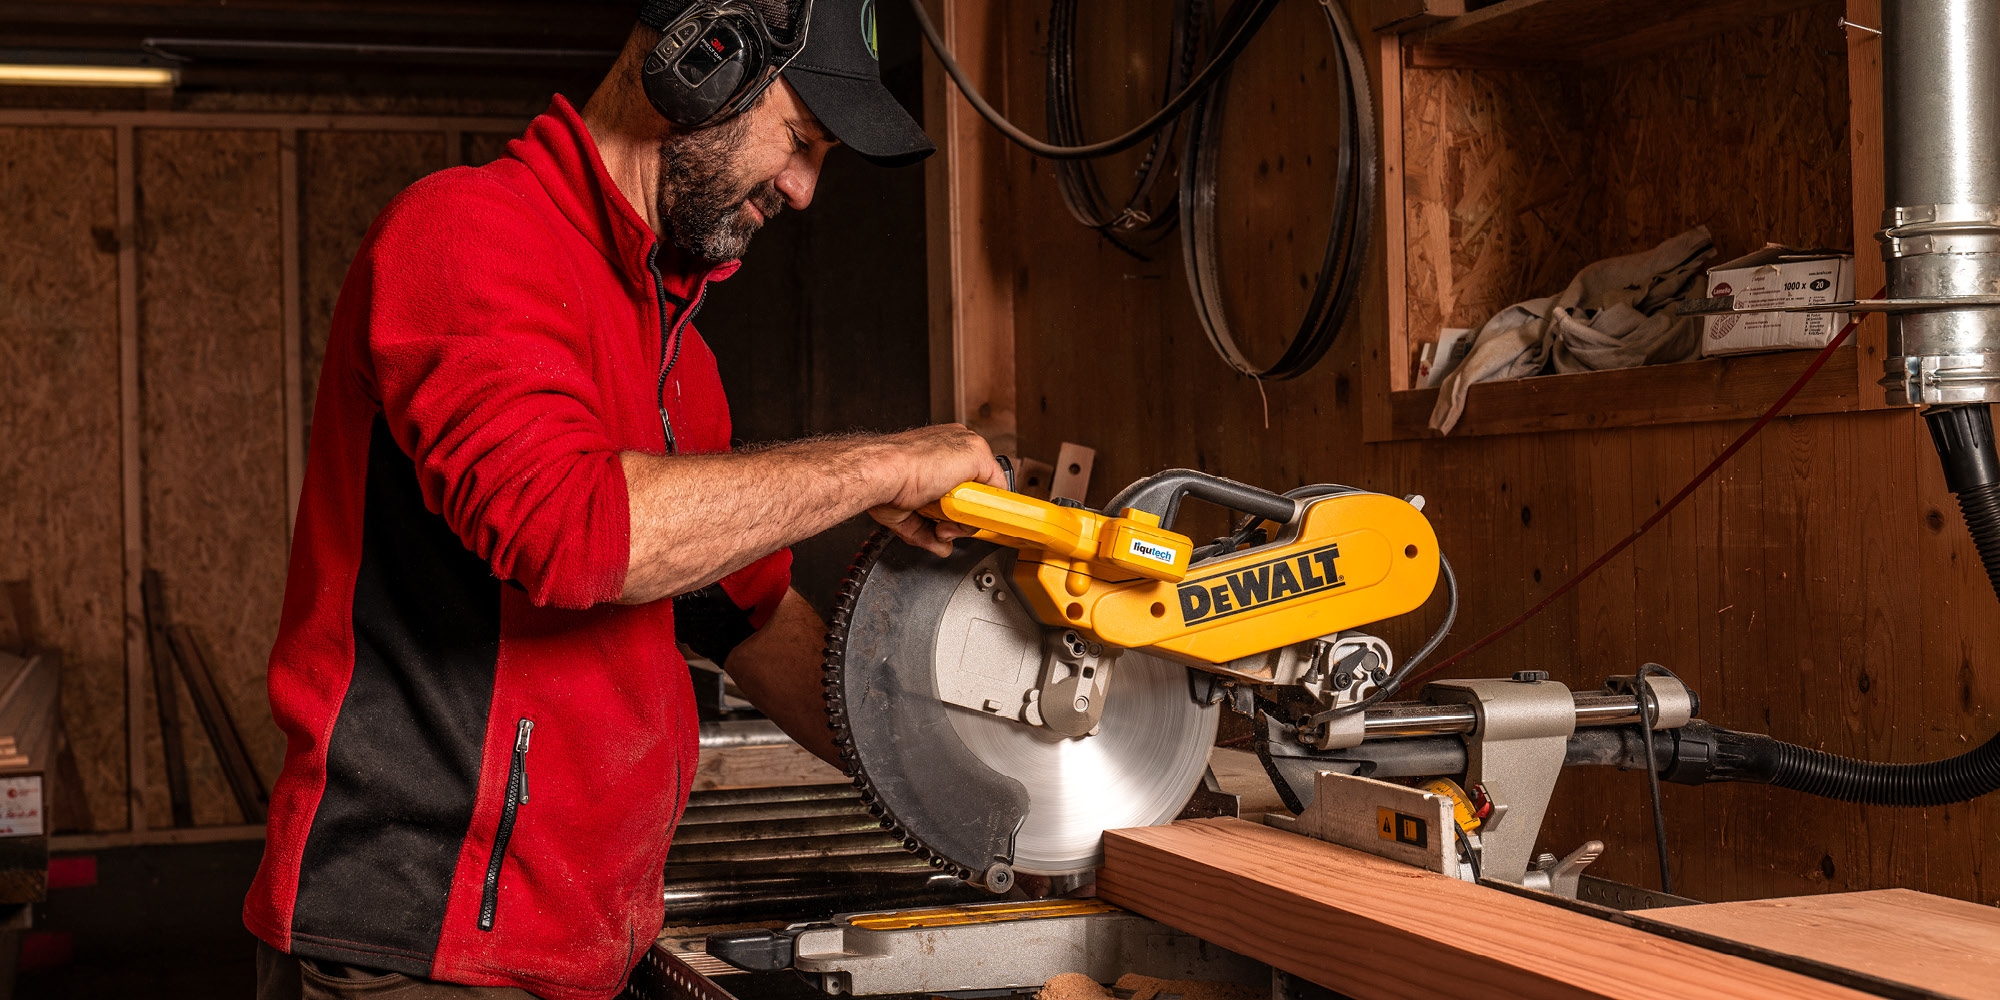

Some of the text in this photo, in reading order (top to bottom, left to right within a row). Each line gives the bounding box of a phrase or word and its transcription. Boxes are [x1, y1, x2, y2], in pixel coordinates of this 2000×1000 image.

[711, 38, 725, 52] 3M
[1713, 287, 1731, 295] Lamello
[1784, 281, 1801, 291] 1000
[1815, 281, 1824, 290] 20
[1133, 541, 1172, 560] liqutech
